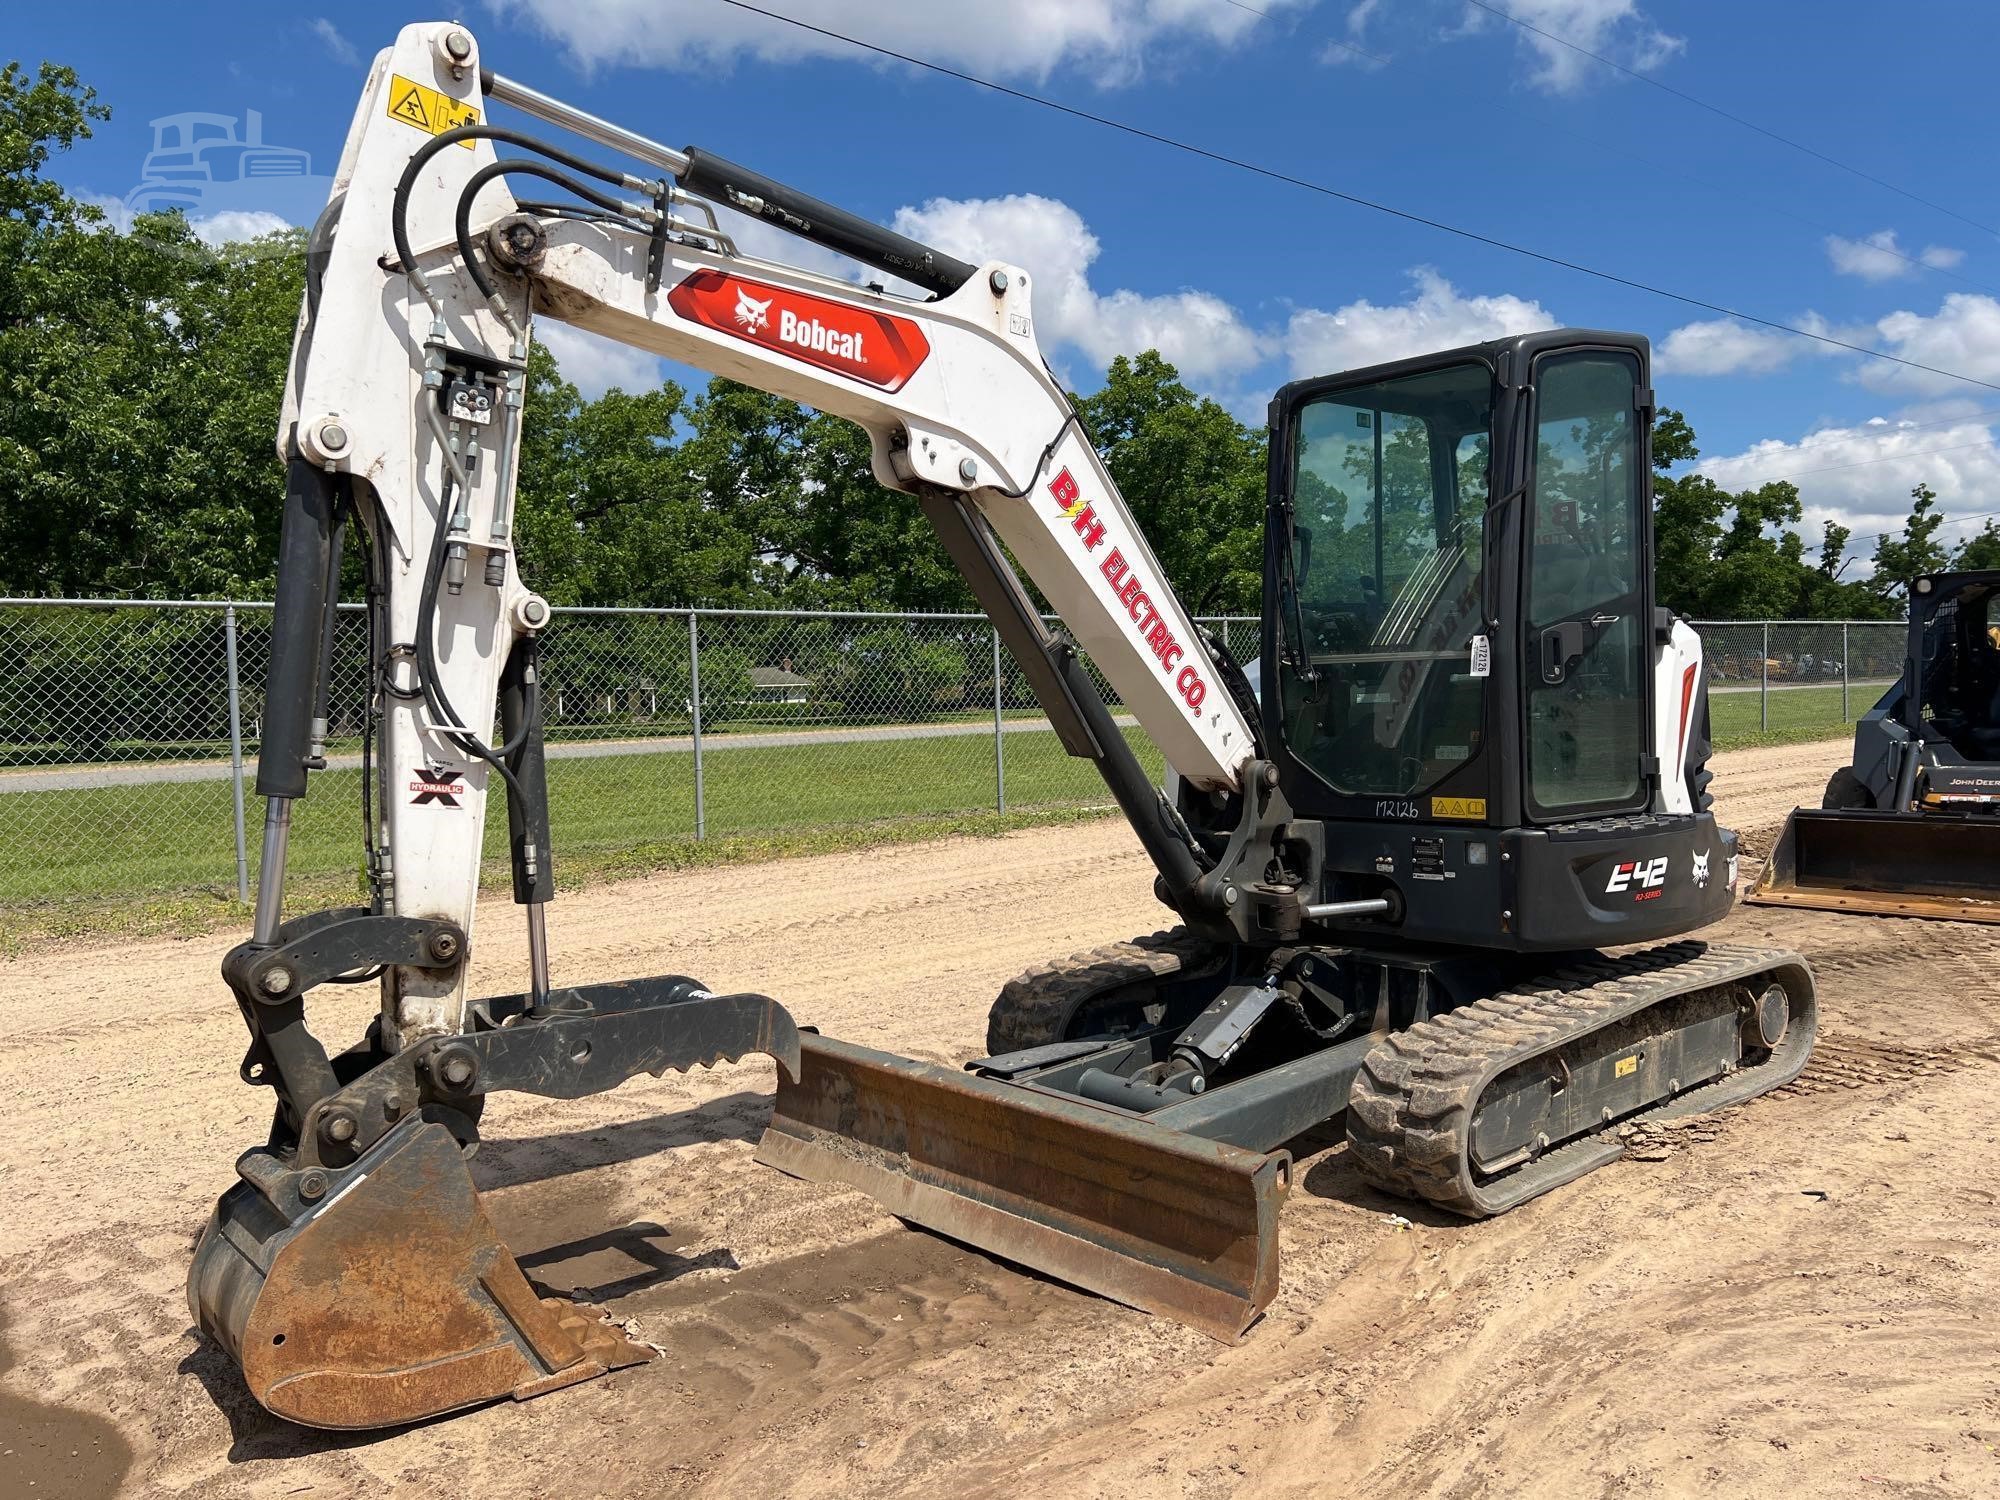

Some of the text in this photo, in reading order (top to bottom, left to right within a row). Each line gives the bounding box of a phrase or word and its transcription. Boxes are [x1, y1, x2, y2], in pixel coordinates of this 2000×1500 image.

[1099, 546, 1185, 675] ELECTRIC
[1176, 665, 1207, 718] CO.
[1478, 644, 1487, 672] 172126
[411, 783, 462, 793] HYDRAULIC
[1949, 778, 1975, 786] JOHN
[1375, 800, 1419, 818] 172126
[1605, 857, 1668, 892] E42
